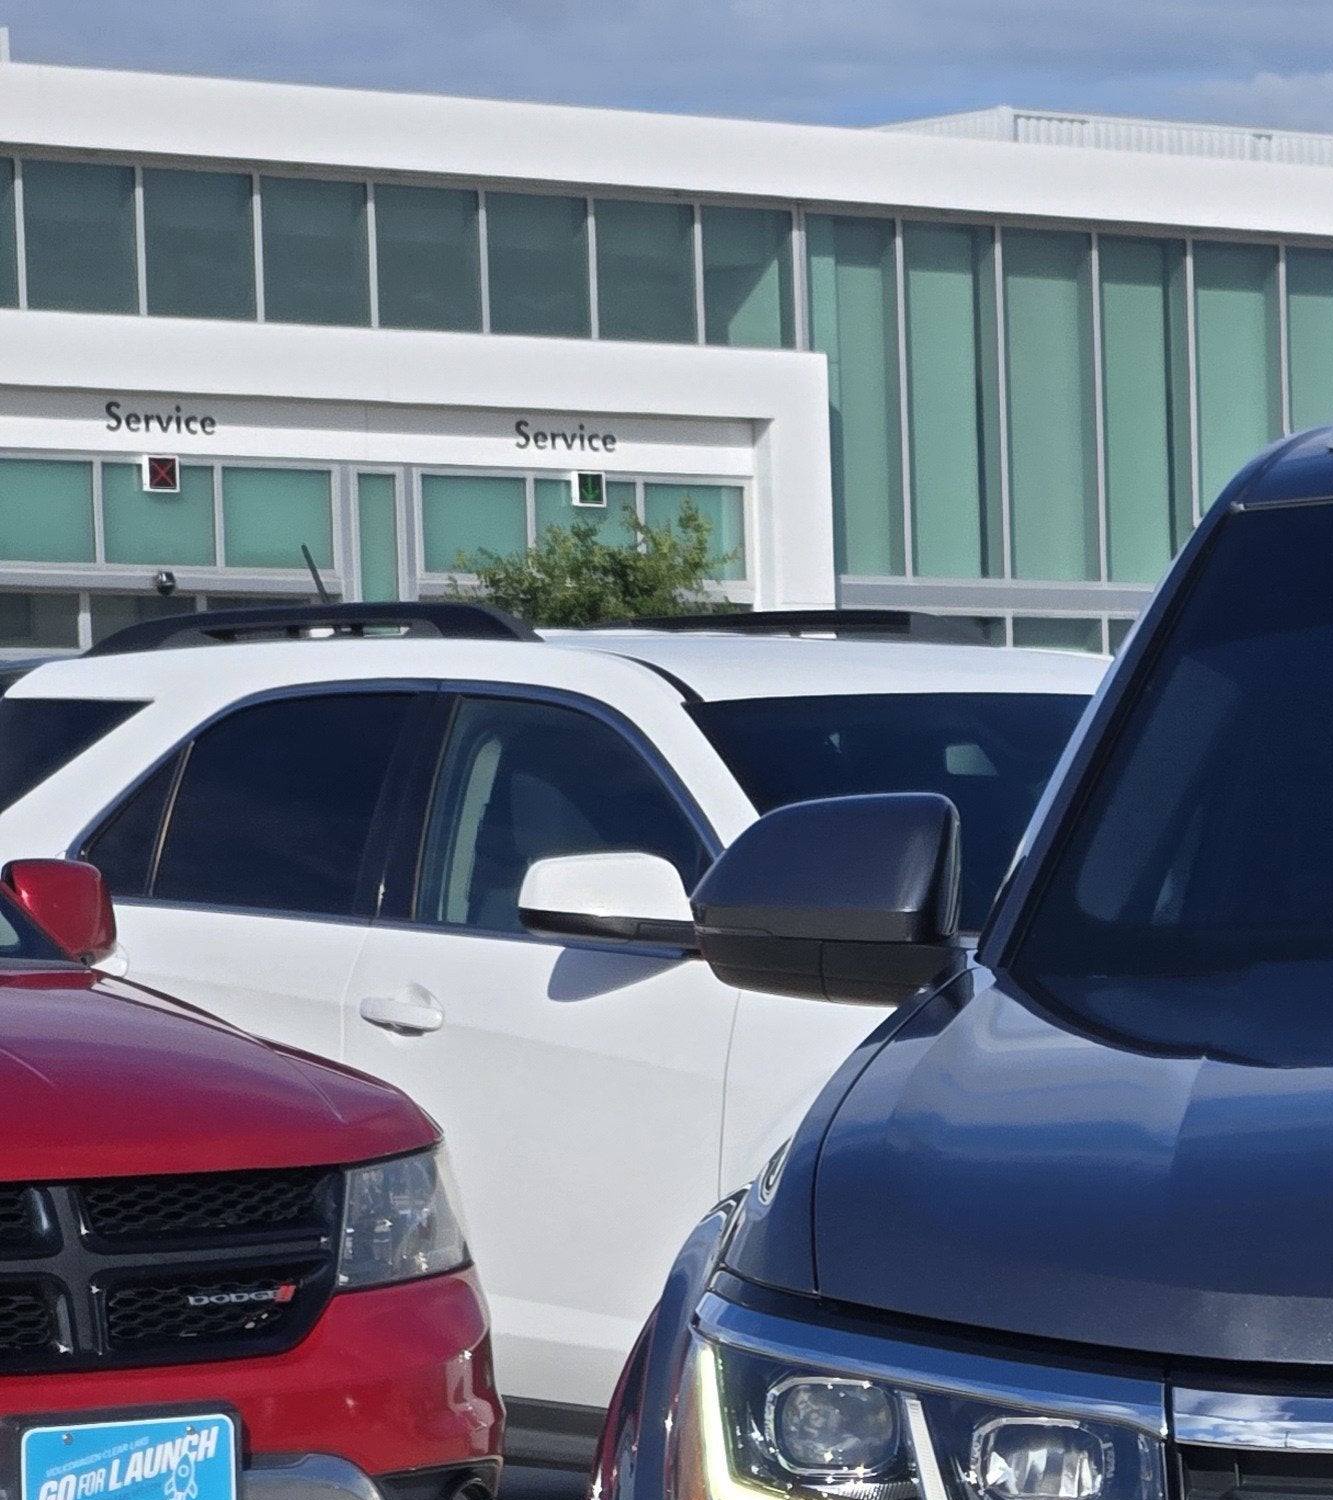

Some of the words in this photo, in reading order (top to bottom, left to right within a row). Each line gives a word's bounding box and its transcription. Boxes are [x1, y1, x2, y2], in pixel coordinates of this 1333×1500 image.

[104, 401, 217, 436] Service
[514, 420, 617, 454] Service
[187, 1290, 279, 1306] DODGE
[77, 1468, 106, 1499] FOR
[108, 1426, 219, 1491] LAUNCH
